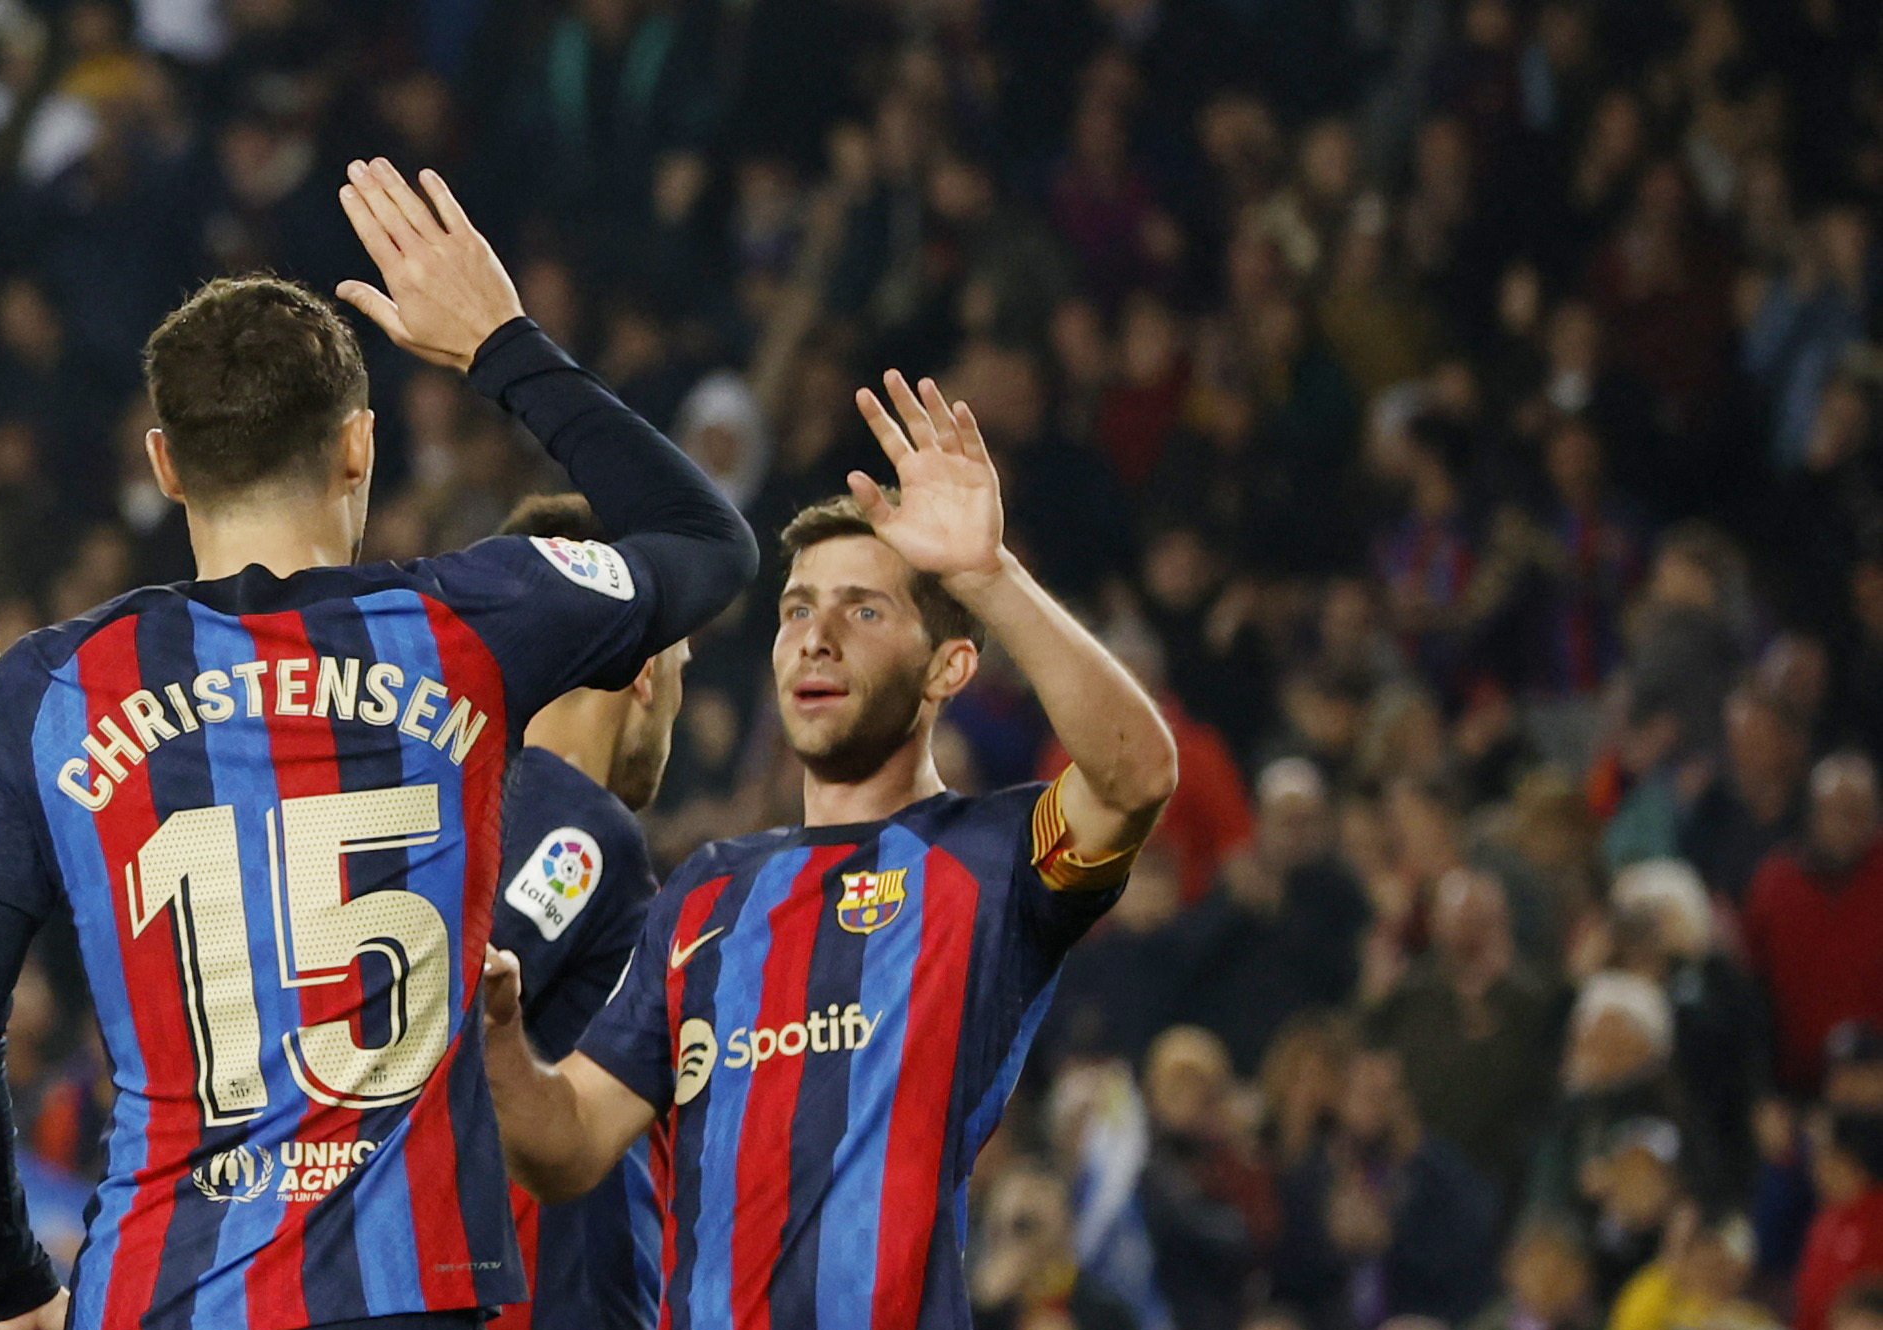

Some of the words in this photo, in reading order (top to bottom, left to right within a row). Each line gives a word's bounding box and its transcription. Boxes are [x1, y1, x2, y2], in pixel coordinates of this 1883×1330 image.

[56, 655, 488, 812] CHRISTENSEN
[520, 879, 565, 926] LaLiga
[124, 783, 451, 1128] 15
[724, 1003, 883, 1072] Spotify
[280, 1140, 381, 1168] UNHC
